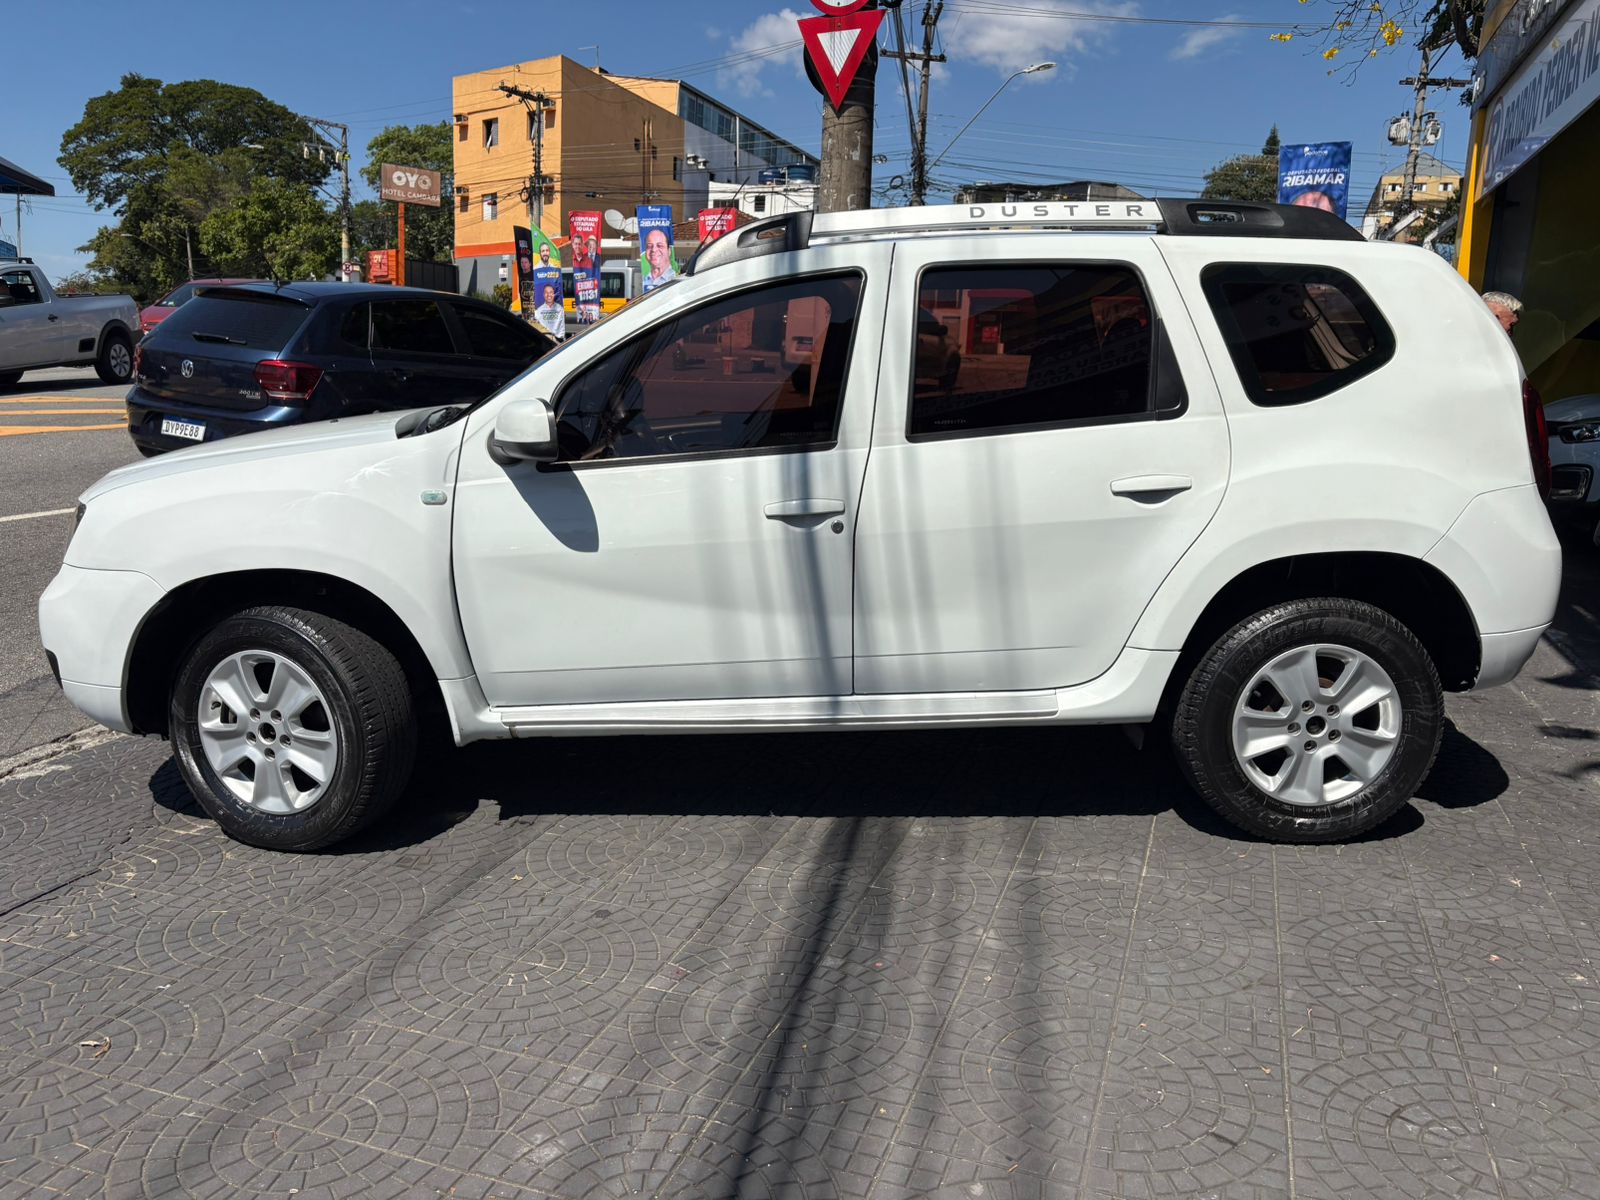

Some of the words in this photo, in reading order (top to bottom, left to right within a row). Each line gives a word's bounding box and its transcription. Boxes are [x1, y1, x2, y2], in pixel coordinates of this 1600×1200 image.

[1540, 21, 1587, 125] PERDER
[392, 170, 432, 190] OYO
[1282, 173, 1345, 188] RIBAMAR
[382, 188, 407, 198] HOTEL
[969, 204, 1144, 219] DUSTER
[165, 421, 200, 438] DYP9E88
